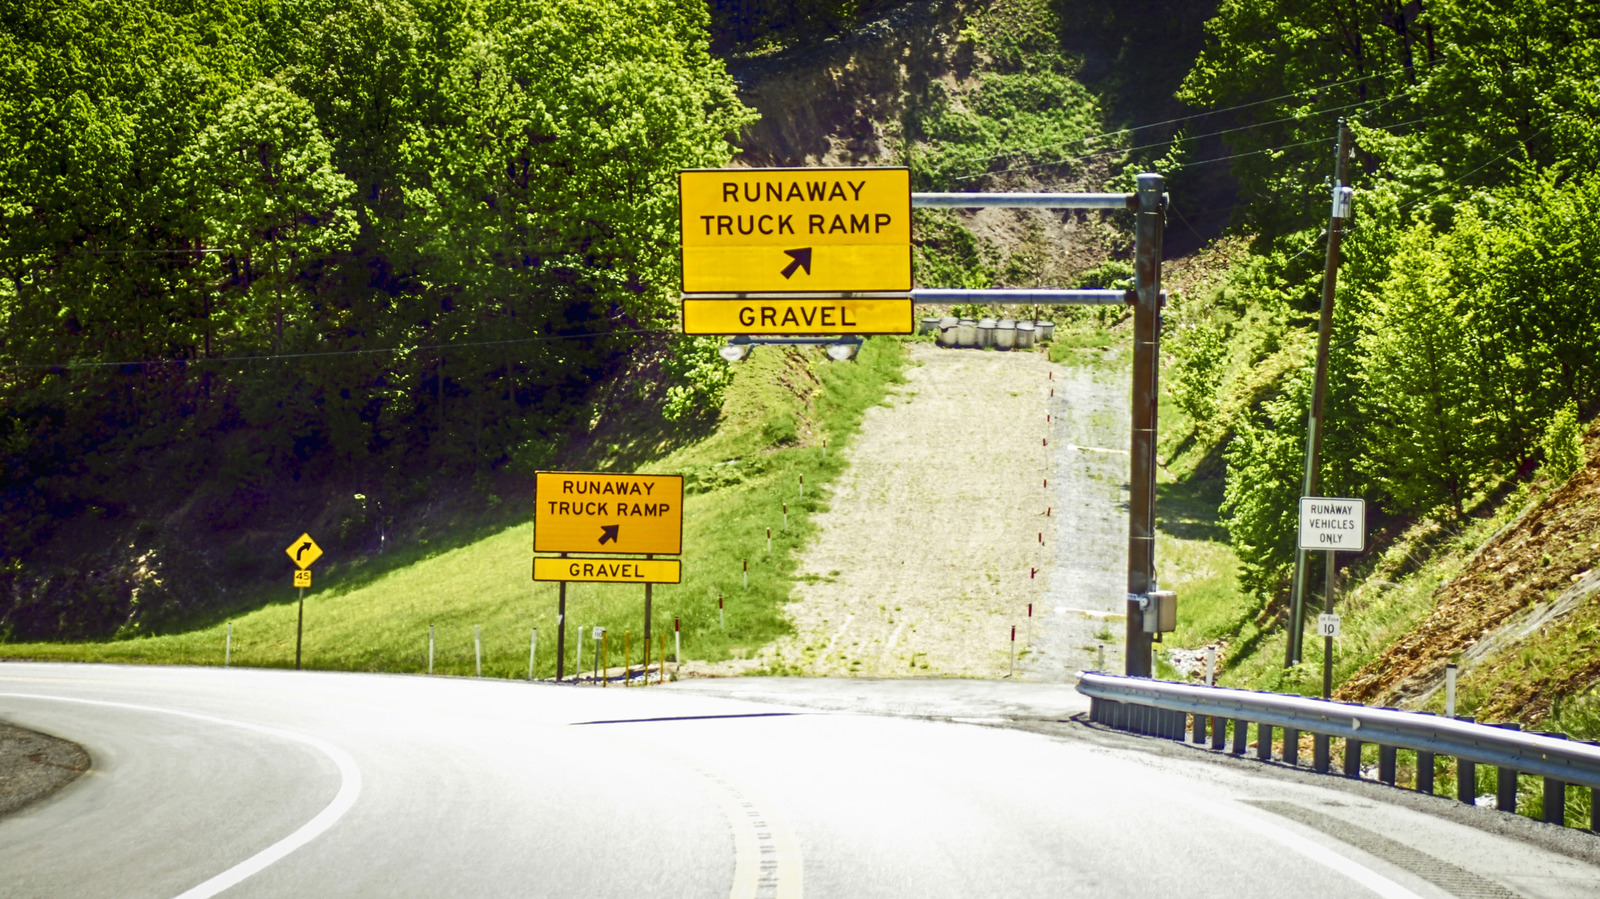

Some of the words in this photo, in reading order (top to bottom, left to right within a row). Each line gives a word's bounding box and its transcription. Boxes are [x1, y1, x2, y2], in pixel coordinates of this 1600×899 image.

[722, 181, 866, 202] RUNAWAY
[700, 214, 795, 235] TRUCK
[809, 213, 892, 234] RAMP
[739, 306, 857, 327] GRAVEL
[563, 481, 655, 495] RUNAWAY
[548, 501, 609, 516] TRUCK
[617, 503, 670, 517] RAMP
[1310, 504, 1353, 515] RUNAWAY
[1309, 519, 1355, 530] VEHICLES
[1319, 533, 1343, 544] ONLY
[296, 572, 310, 581] 45
[569, 563, 645, 578] GRAVEL
